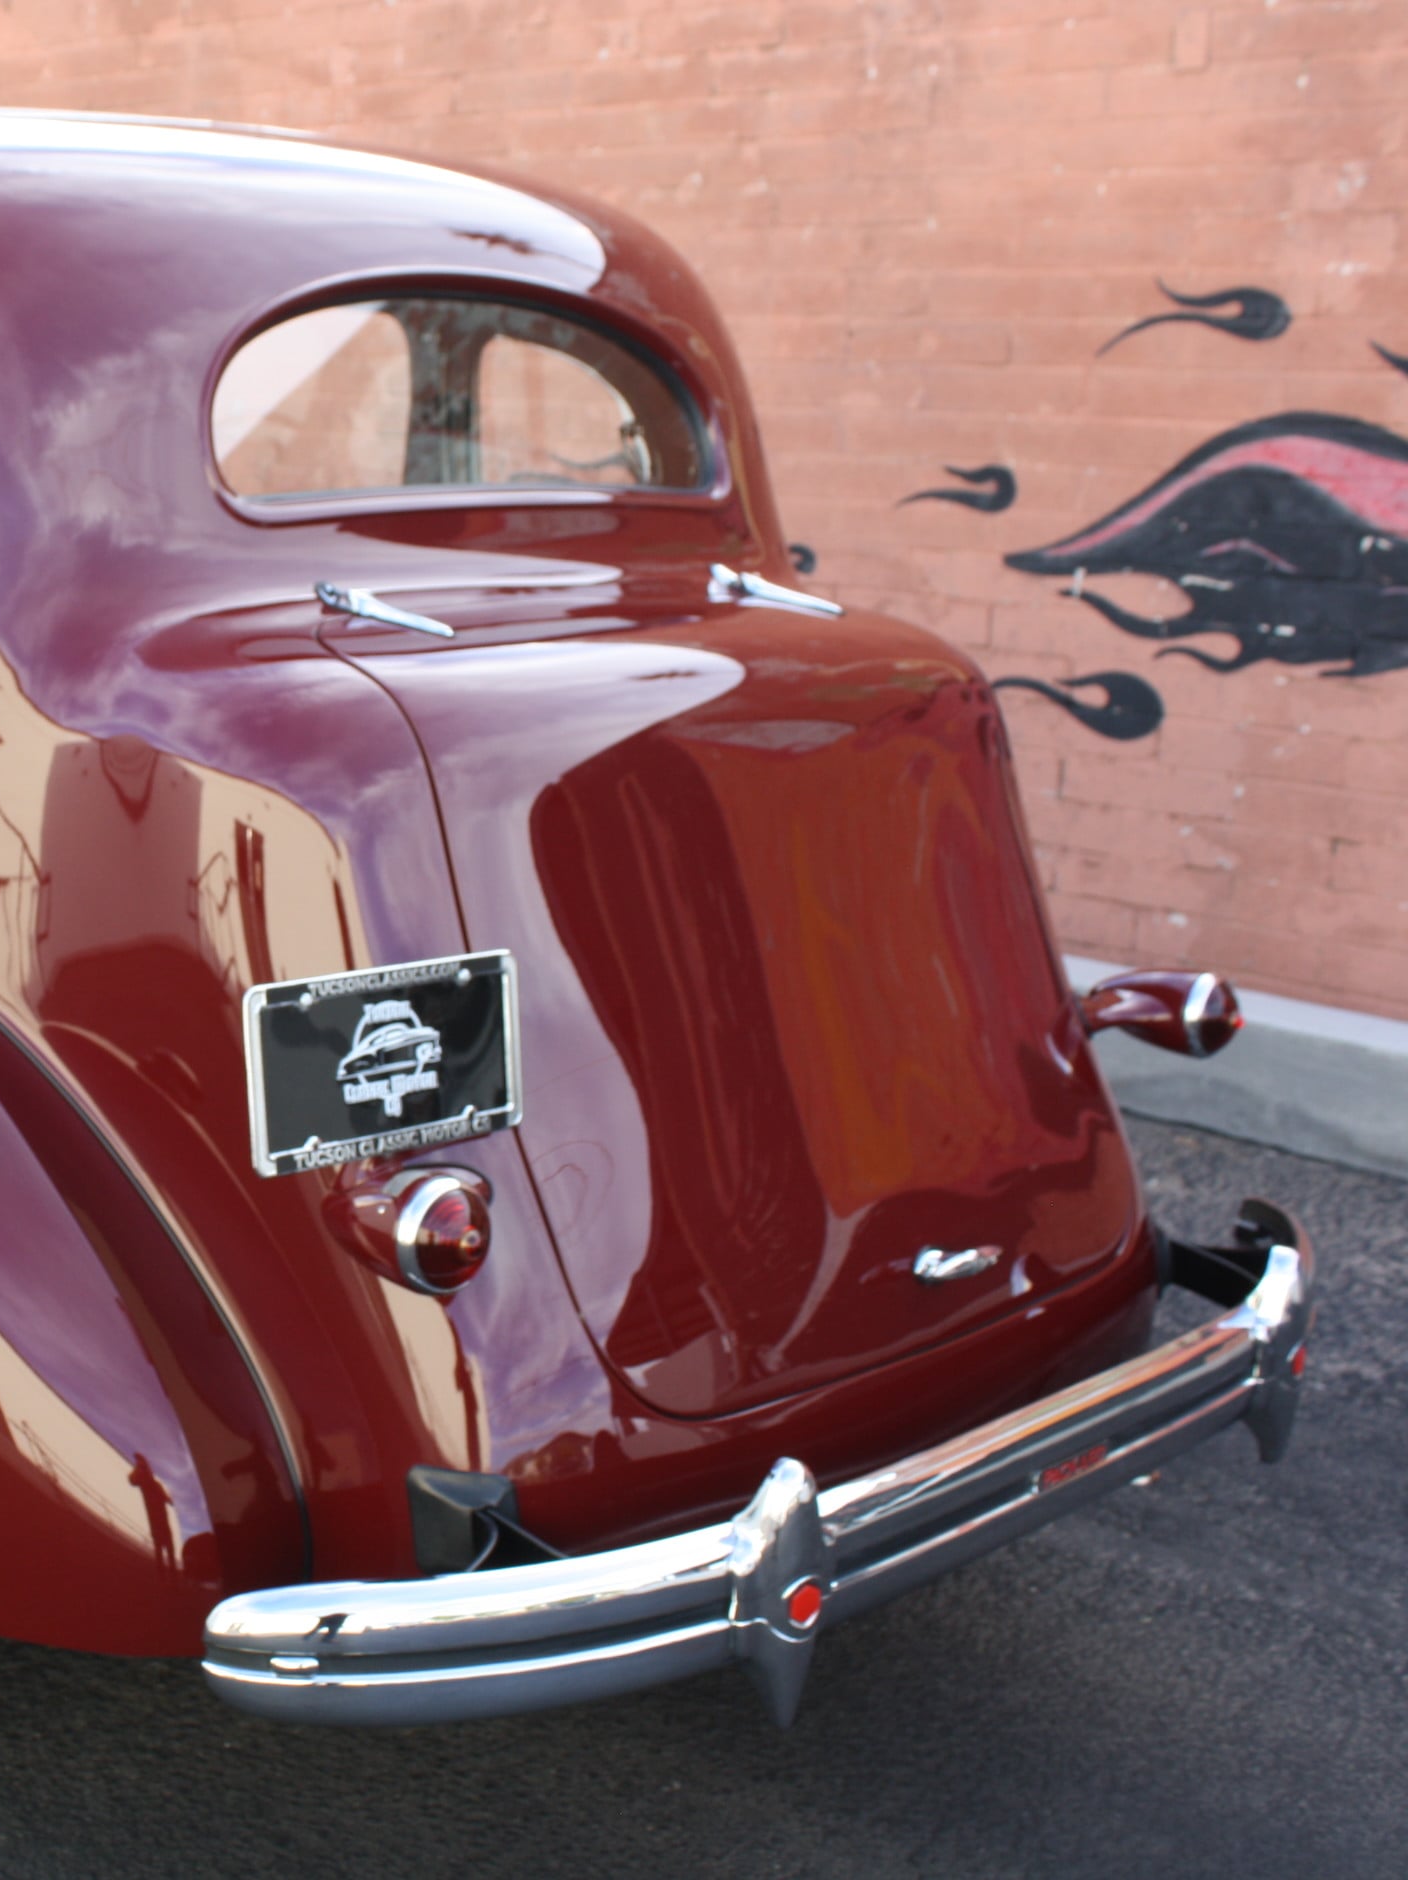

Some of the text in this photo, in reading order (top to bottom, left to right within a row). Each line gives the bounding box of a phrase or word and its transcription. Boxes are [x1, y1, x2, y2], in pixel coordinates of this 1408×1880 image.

[293, 1144, 357, 1170] TUCSON
[358, 1132, 420, 1157] CLASSIC
[420, 1120, 471, 1145] MOTOR
